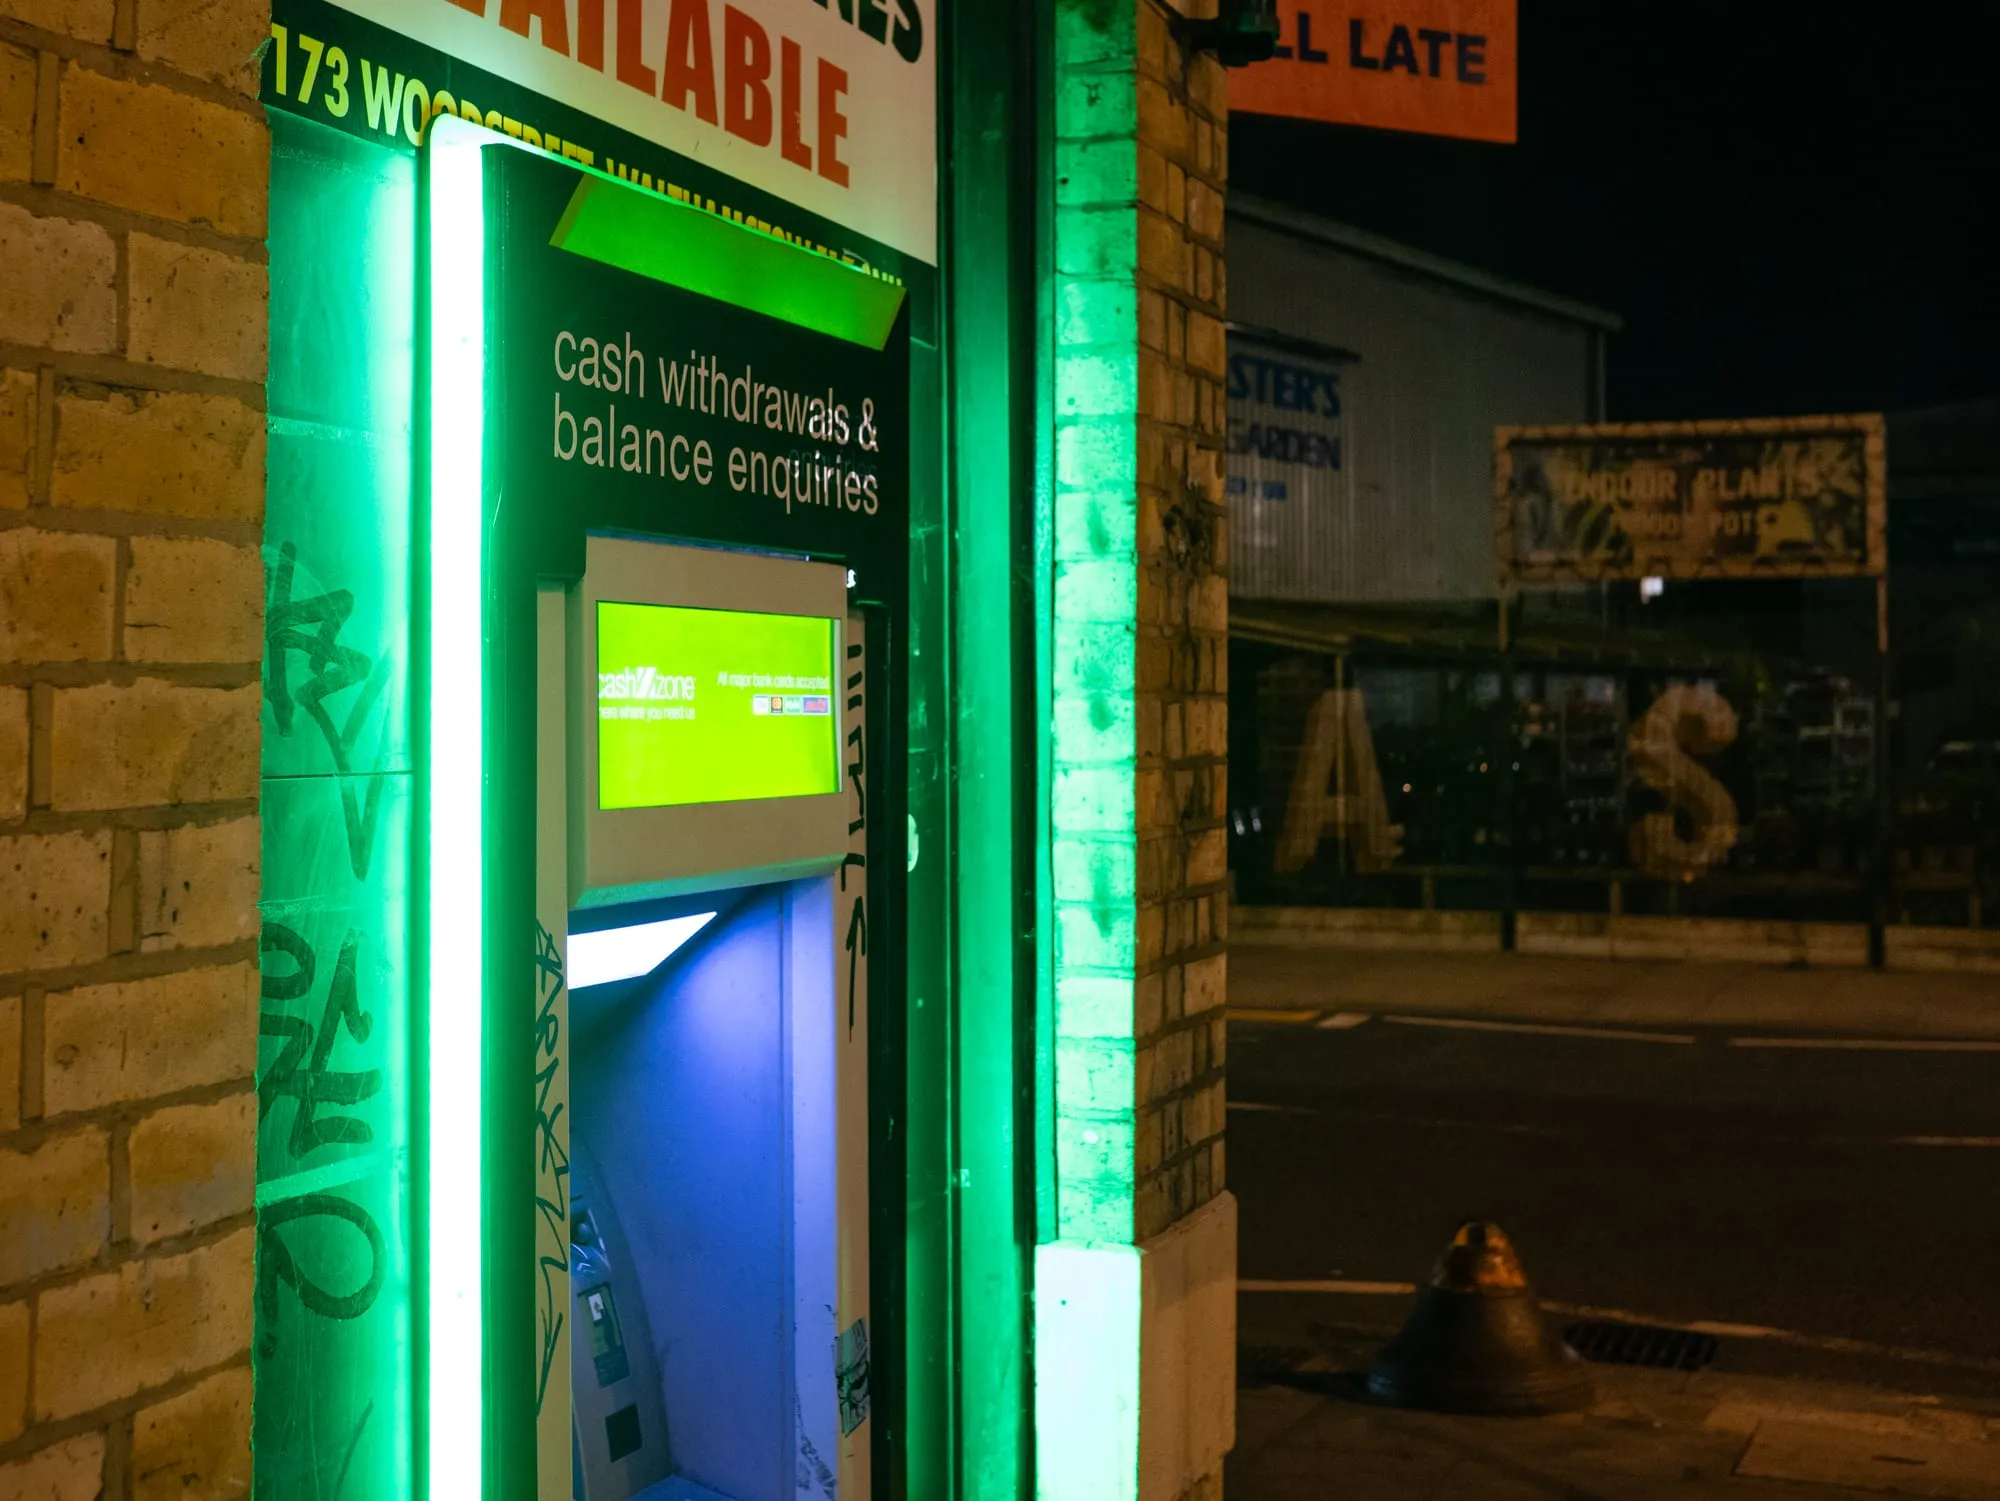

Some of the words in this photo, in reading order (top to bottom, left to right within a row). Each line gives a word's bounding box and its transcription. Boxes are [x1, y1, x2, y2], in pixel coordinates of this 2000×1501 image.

[271, 23, 350, 118] 173
[1273, 12, 1329, 64] L
[1350, 18, 1487, 85] LATE
[554, 331, 645, 398] cash
[658, 350, 850, 446] withdrawals
[858, 397, 879, 452] &
[553, 392, 713, 486] balance
[728, 446, 879, 516] enquiries
